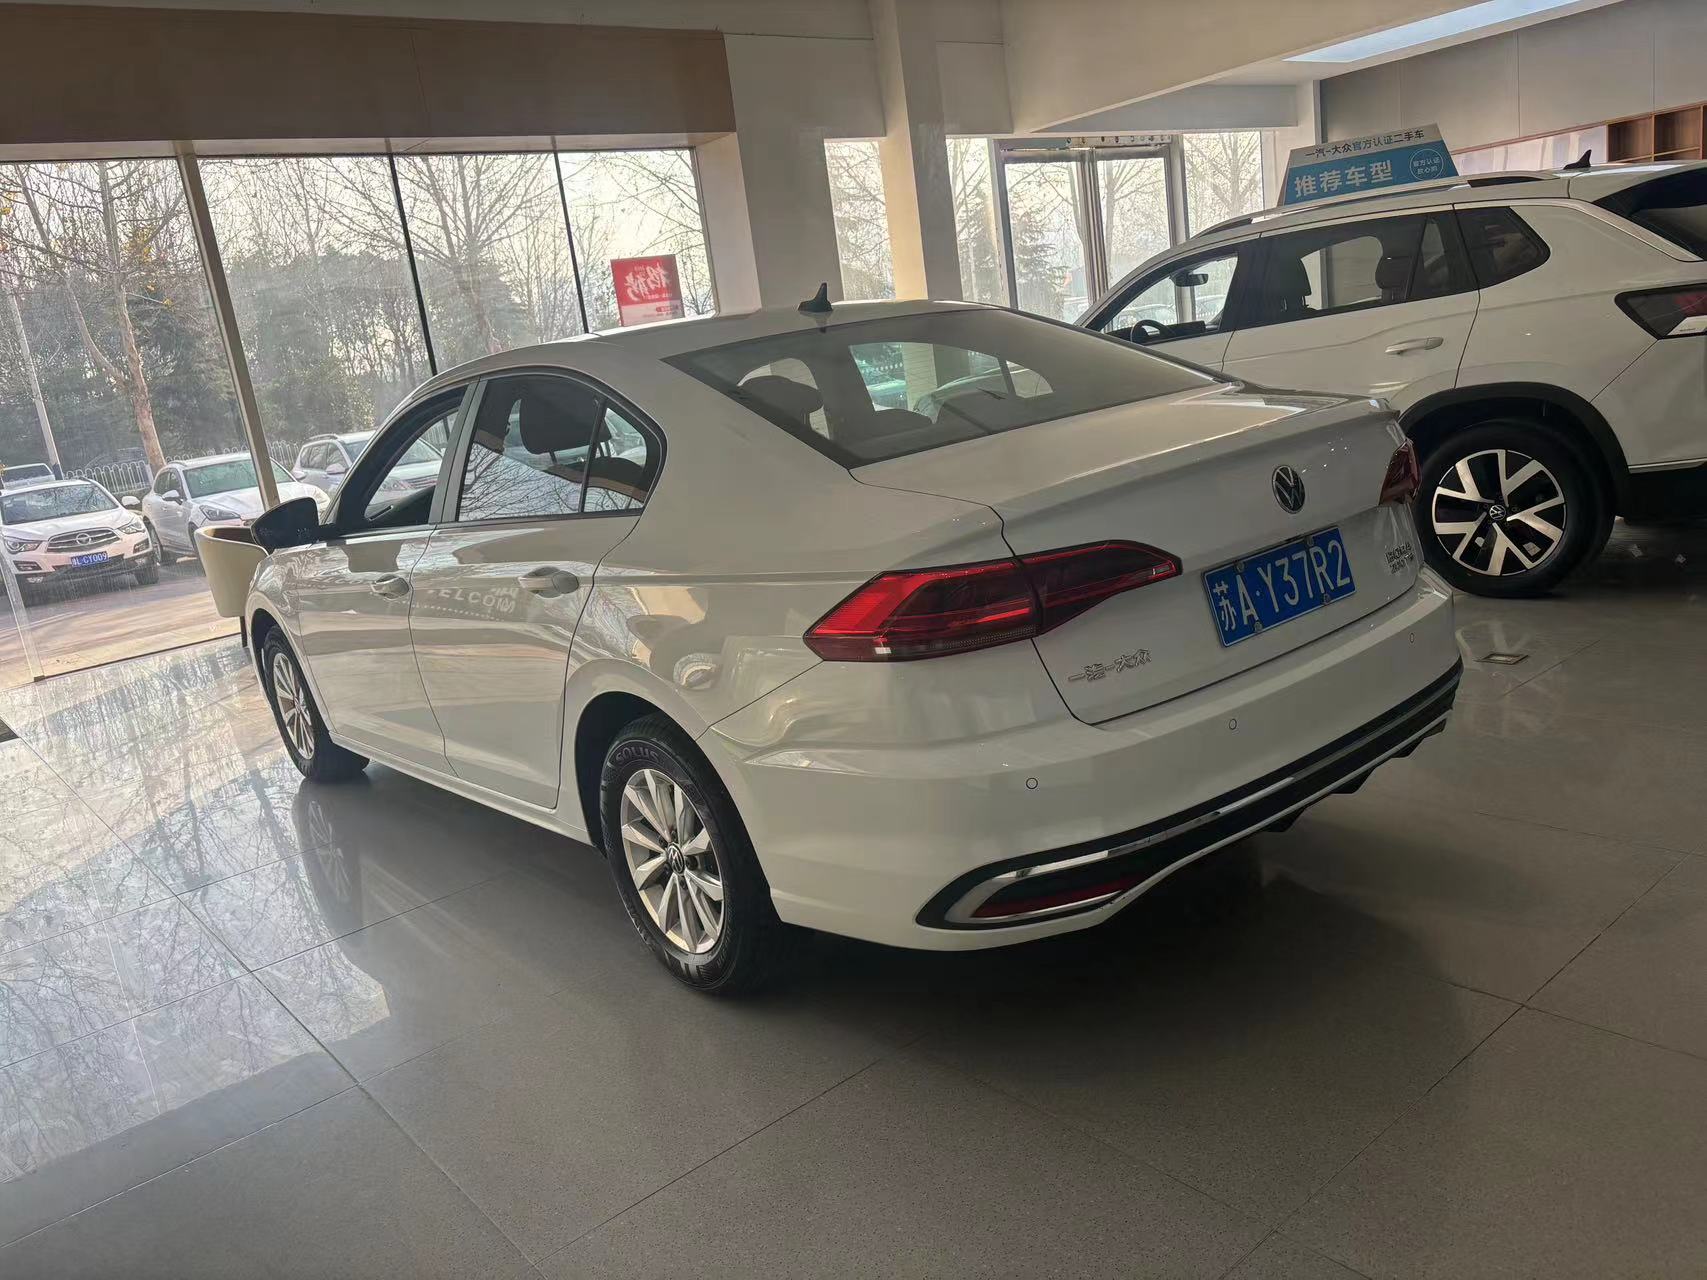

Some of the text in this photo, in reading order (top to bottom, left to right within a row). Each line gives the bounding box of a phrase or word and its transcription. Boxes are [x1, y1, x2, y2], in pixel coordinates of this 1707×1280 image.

[1294, 160, 1393, 198] 推荐车型
[1213, 540, 1350, 631] 苏A·Y37R2
[1068, 648, 1152, 682] 一汽-大众
